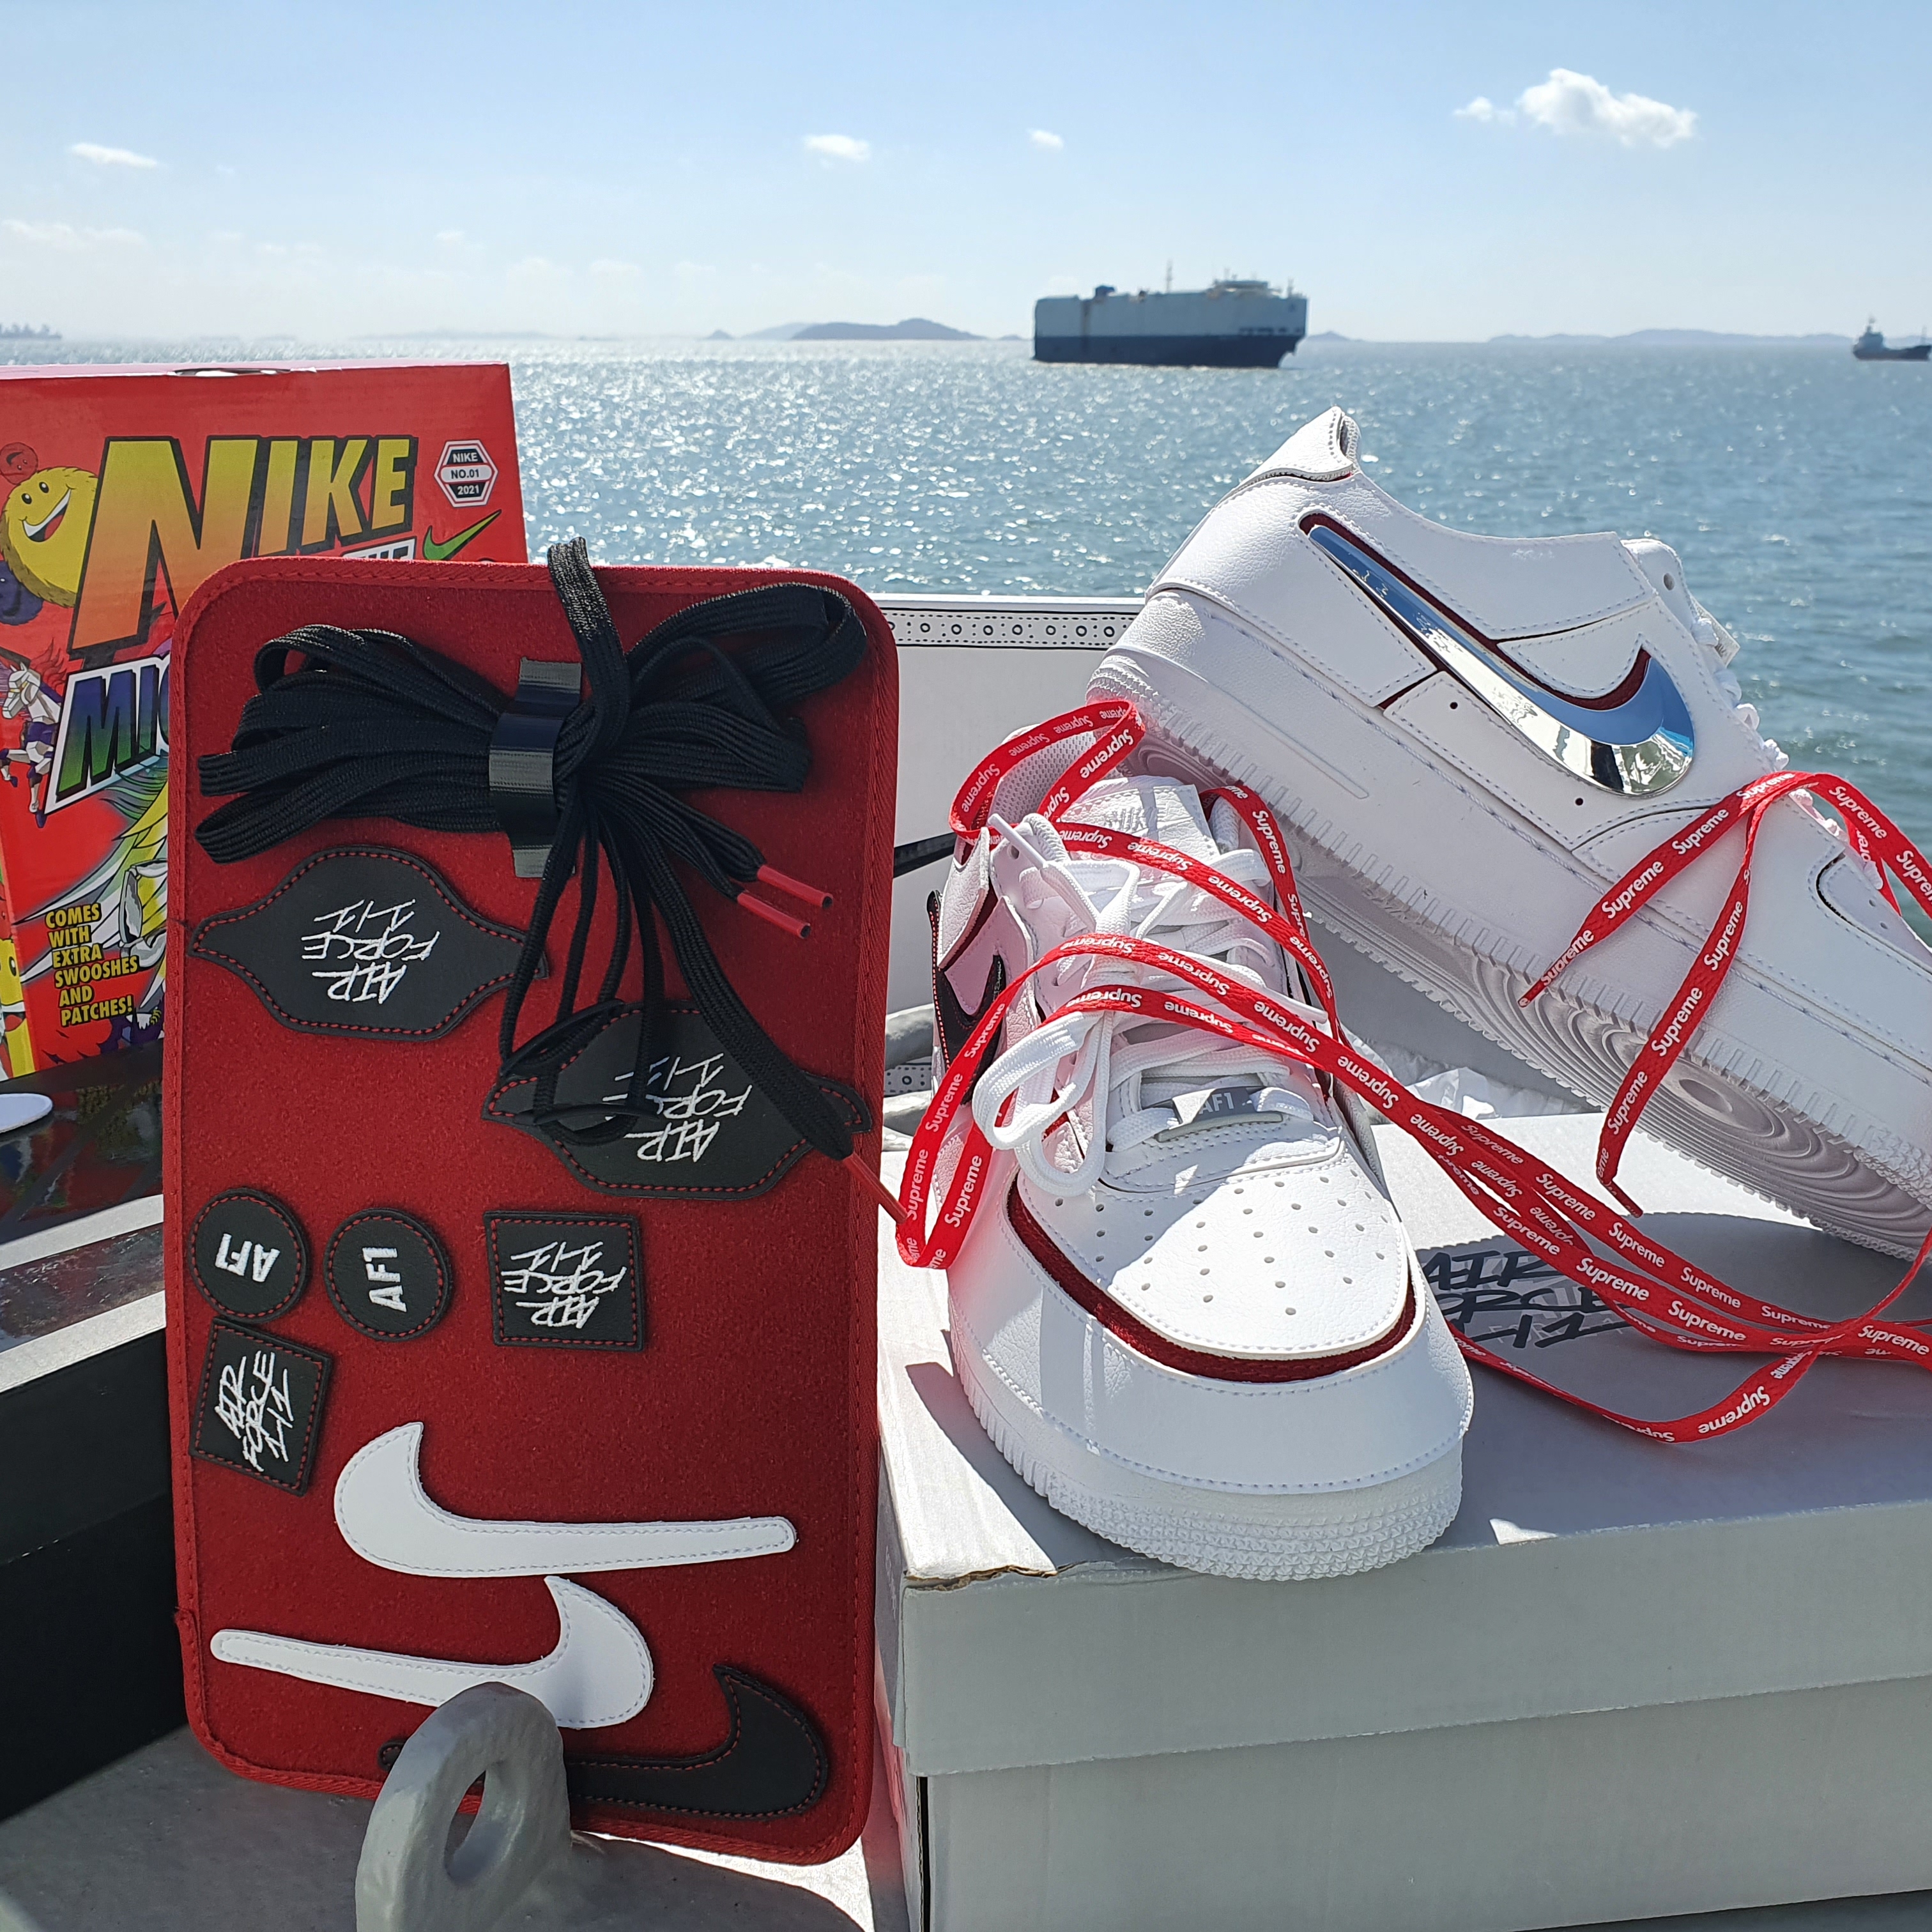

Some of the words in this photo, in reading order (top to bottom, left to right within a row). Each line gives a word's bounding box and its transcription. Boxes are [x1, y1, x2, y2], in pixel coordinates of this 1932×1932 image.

[450, 469, 480, 479] NO.01
[452, 452, 479, 463] NIKE
[457, 484, 480, 495] 2021
[69, 436, 417, 653] NIKE
[1008, 733, 1051, 757] Supreme
[1053, 715, 1094, 735] Supreme
[1080, 729, 1134, 779] Supreme
[961, 763, 1000, 813] Supreme
[1736, 772, 1796, 800] Supreme
[1671, 808, 1729, 855] Supreme
[1828, 786, 1888, 839] Supreme
[1127, 841, 1193, 871] Supreme
[1252, 809, 1286, 875] Supreme
[1208, 875, 1273, 924] Supreme
[1601, 861, 1665, 919] Supreme
[45, 903, 102, 928] COMES
[49, 925, 91, 949] WITH
[1704, 900, 1744, 971] Supreme
[52, 944, 103, 969] EXTRA
[302, 931, 440, 961] FORCE
[1289, 935, 1333, 1000] Supreme
[1540, 929, 1595, 986] Supreme
[54, 956, 138, 988] SWOOSHES
[312, 961, 408, 1004] AIR
[1157, 951, 1231, 996] Supreme
[59, 985, 94, 1008] AND
[61, 995, 134, 1027] PATCHES!
[1163, 1000, 1234, 1034] Supreme
[963, 1002, 1006, 1059] Supreme
[1254, 1000, 1321, 1054] Supreme
[1650, 986, 1703, 1057] Supreme
[924, 1072, 964, 1133] Supreme
[1337, 1055, 1399, 1110] Supreme
[1606, 1070, 1648, 1135] Supreme
[624, 1119, 721, 1163] AIR
[1409, 1113, 1465, 1156] Supreme
[1460, 1124, 1524, 1165] Supreme
[907, 1149, 930, 1221] Supreme
[944, 1154, 983, 1229] Supreme
[1471, 1160, 1523, 1199] Supreme
[1535, 1173, 1596, 1221] Supreme
[1492, 1206, 1561, 1256] Supreme
[1608, 1221, 1666, 1268] Supreme
[215, 1233, 281, 1283] AF1
[362, 1246, 407, 1312] AF1
[500, 1266, 627, 1295] FORCE
[1575, 1257, 1650, 1301] Supreme
[1680, 1266, 1742, 1309] Supreme
[515, 1294, 601, 1330] AIR
[1667, 1300, 1747, 1342] Supreme
[1857, 1324, 1930, 1356] Supreme
[242, 1351, 275, 1472] FORCE
[1697, 1386, 1771, 1435] Supreme
